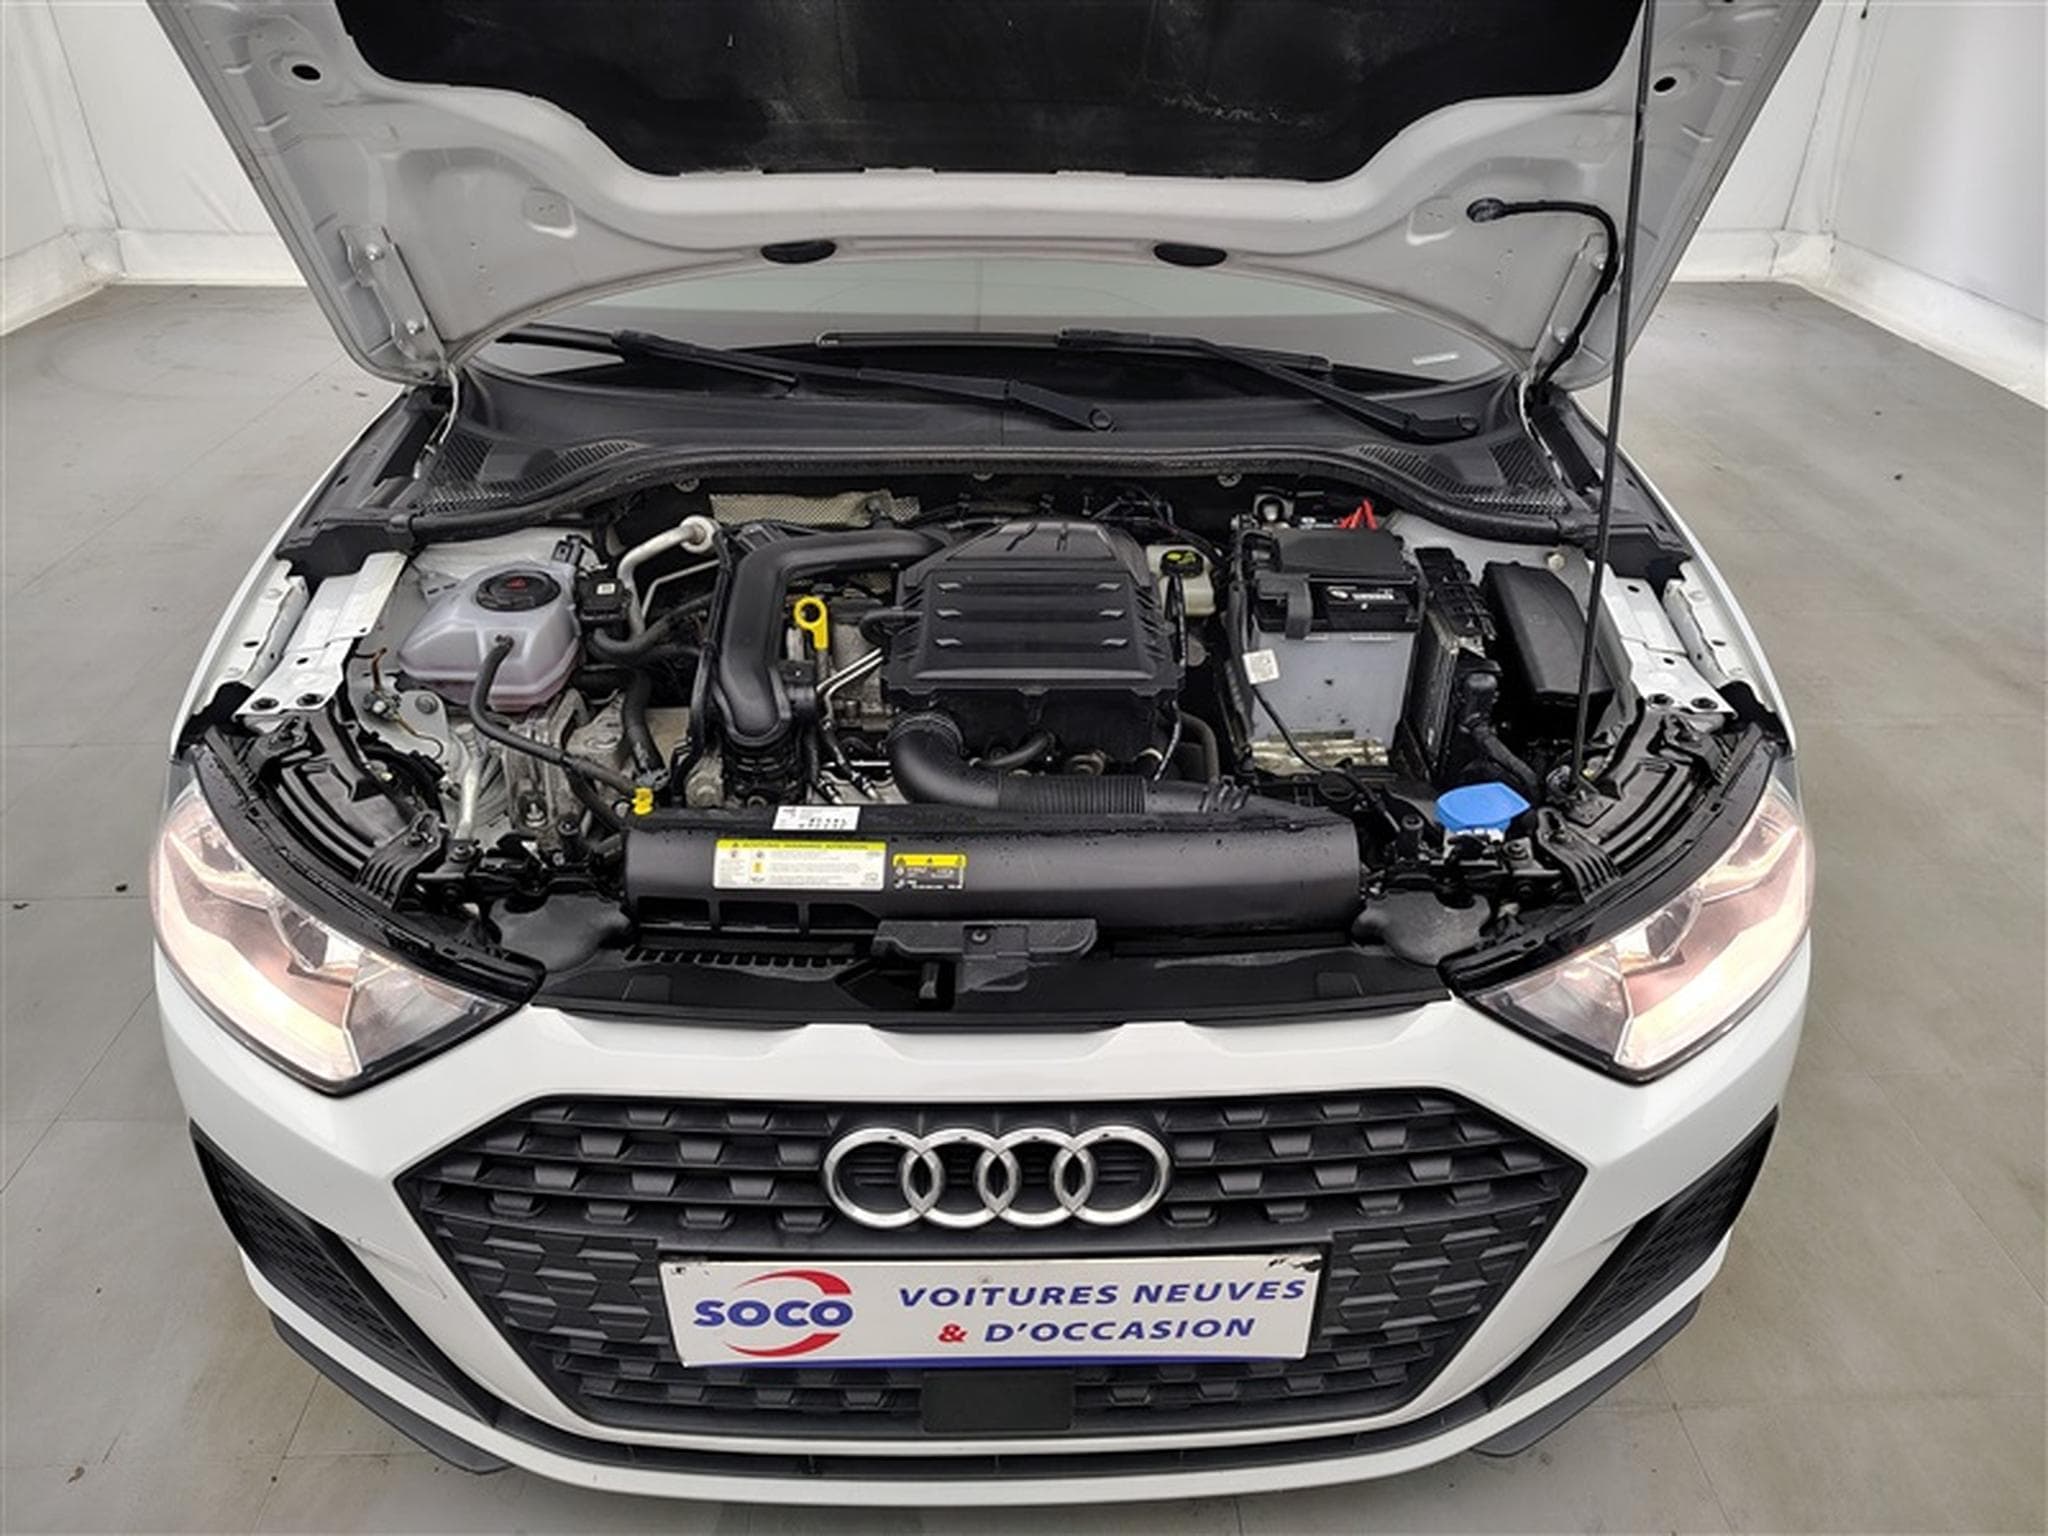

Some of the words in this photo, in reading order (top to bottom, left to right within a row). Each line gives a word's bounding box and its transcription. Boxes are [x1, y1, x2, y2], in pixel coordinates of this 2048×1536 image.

[900, 1285, 1118, 1307] VOITURES
[1133, 1279, 1306, 1303] NEUVES
[694, 1299, 853, 1328] SOCO
[938, 1323, 968, 1344] &
[984, 1318, 1255, 1343] D'OCCASION
